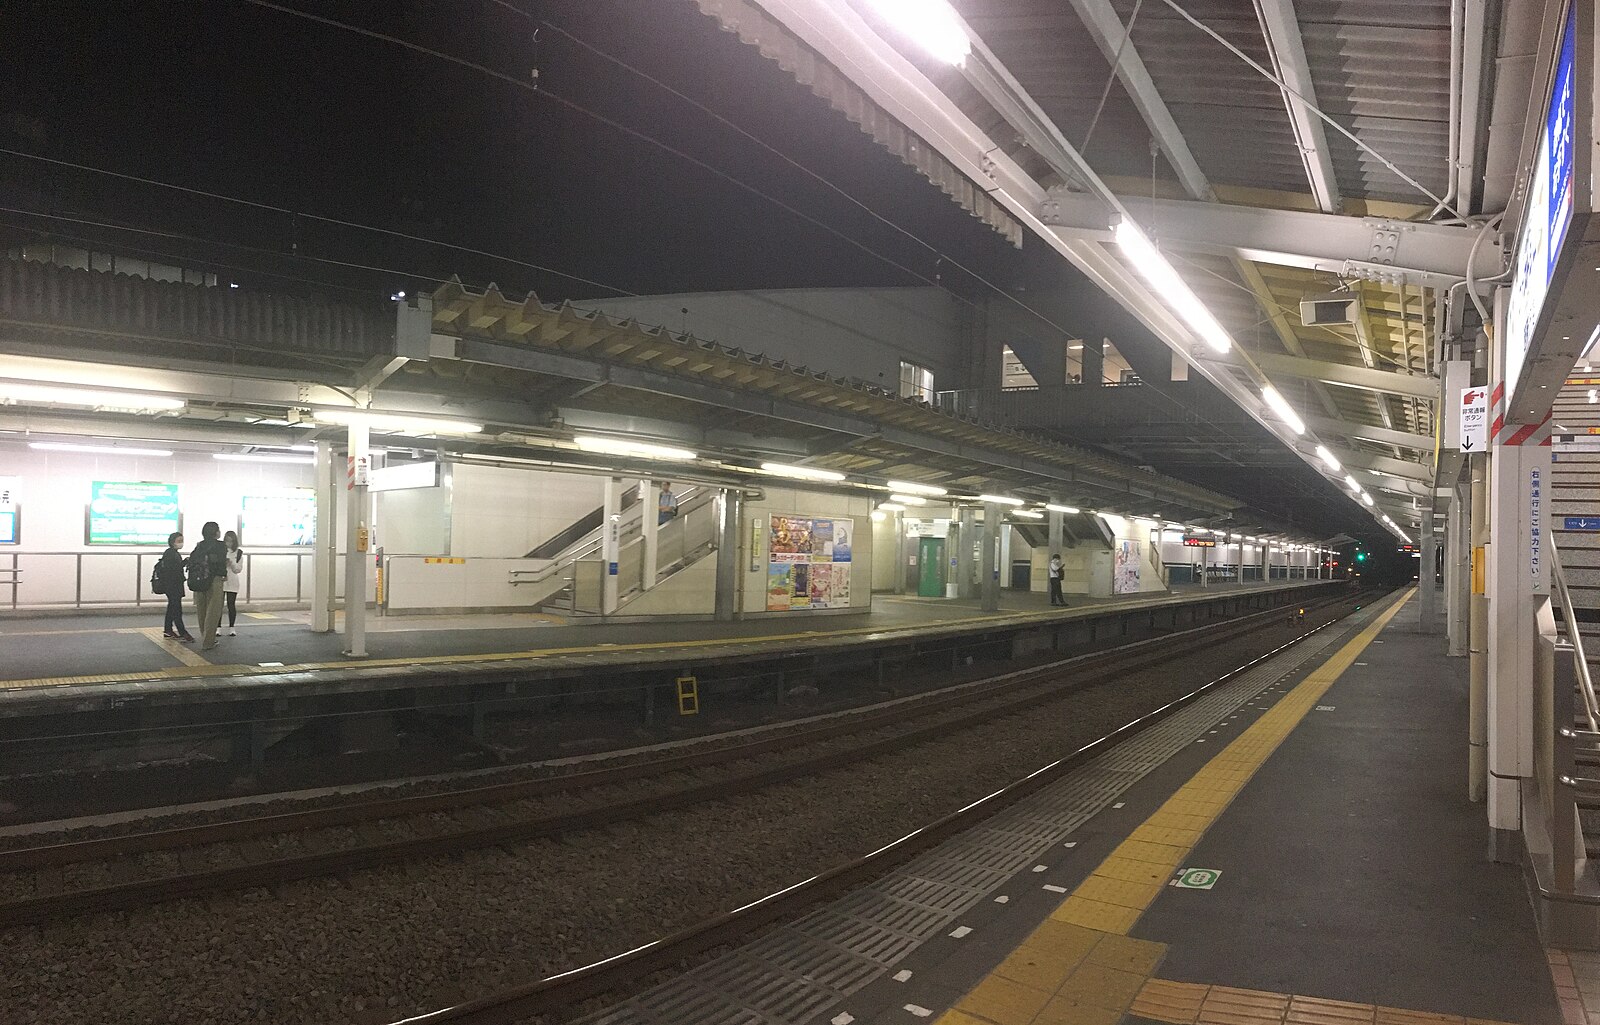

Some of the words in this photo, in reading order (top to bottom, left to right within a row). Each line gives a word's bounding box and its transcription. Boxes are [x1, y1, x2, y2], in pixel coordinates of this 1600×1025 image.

[1531, 470, 1540, 574] 右側通行にご協力下さい
